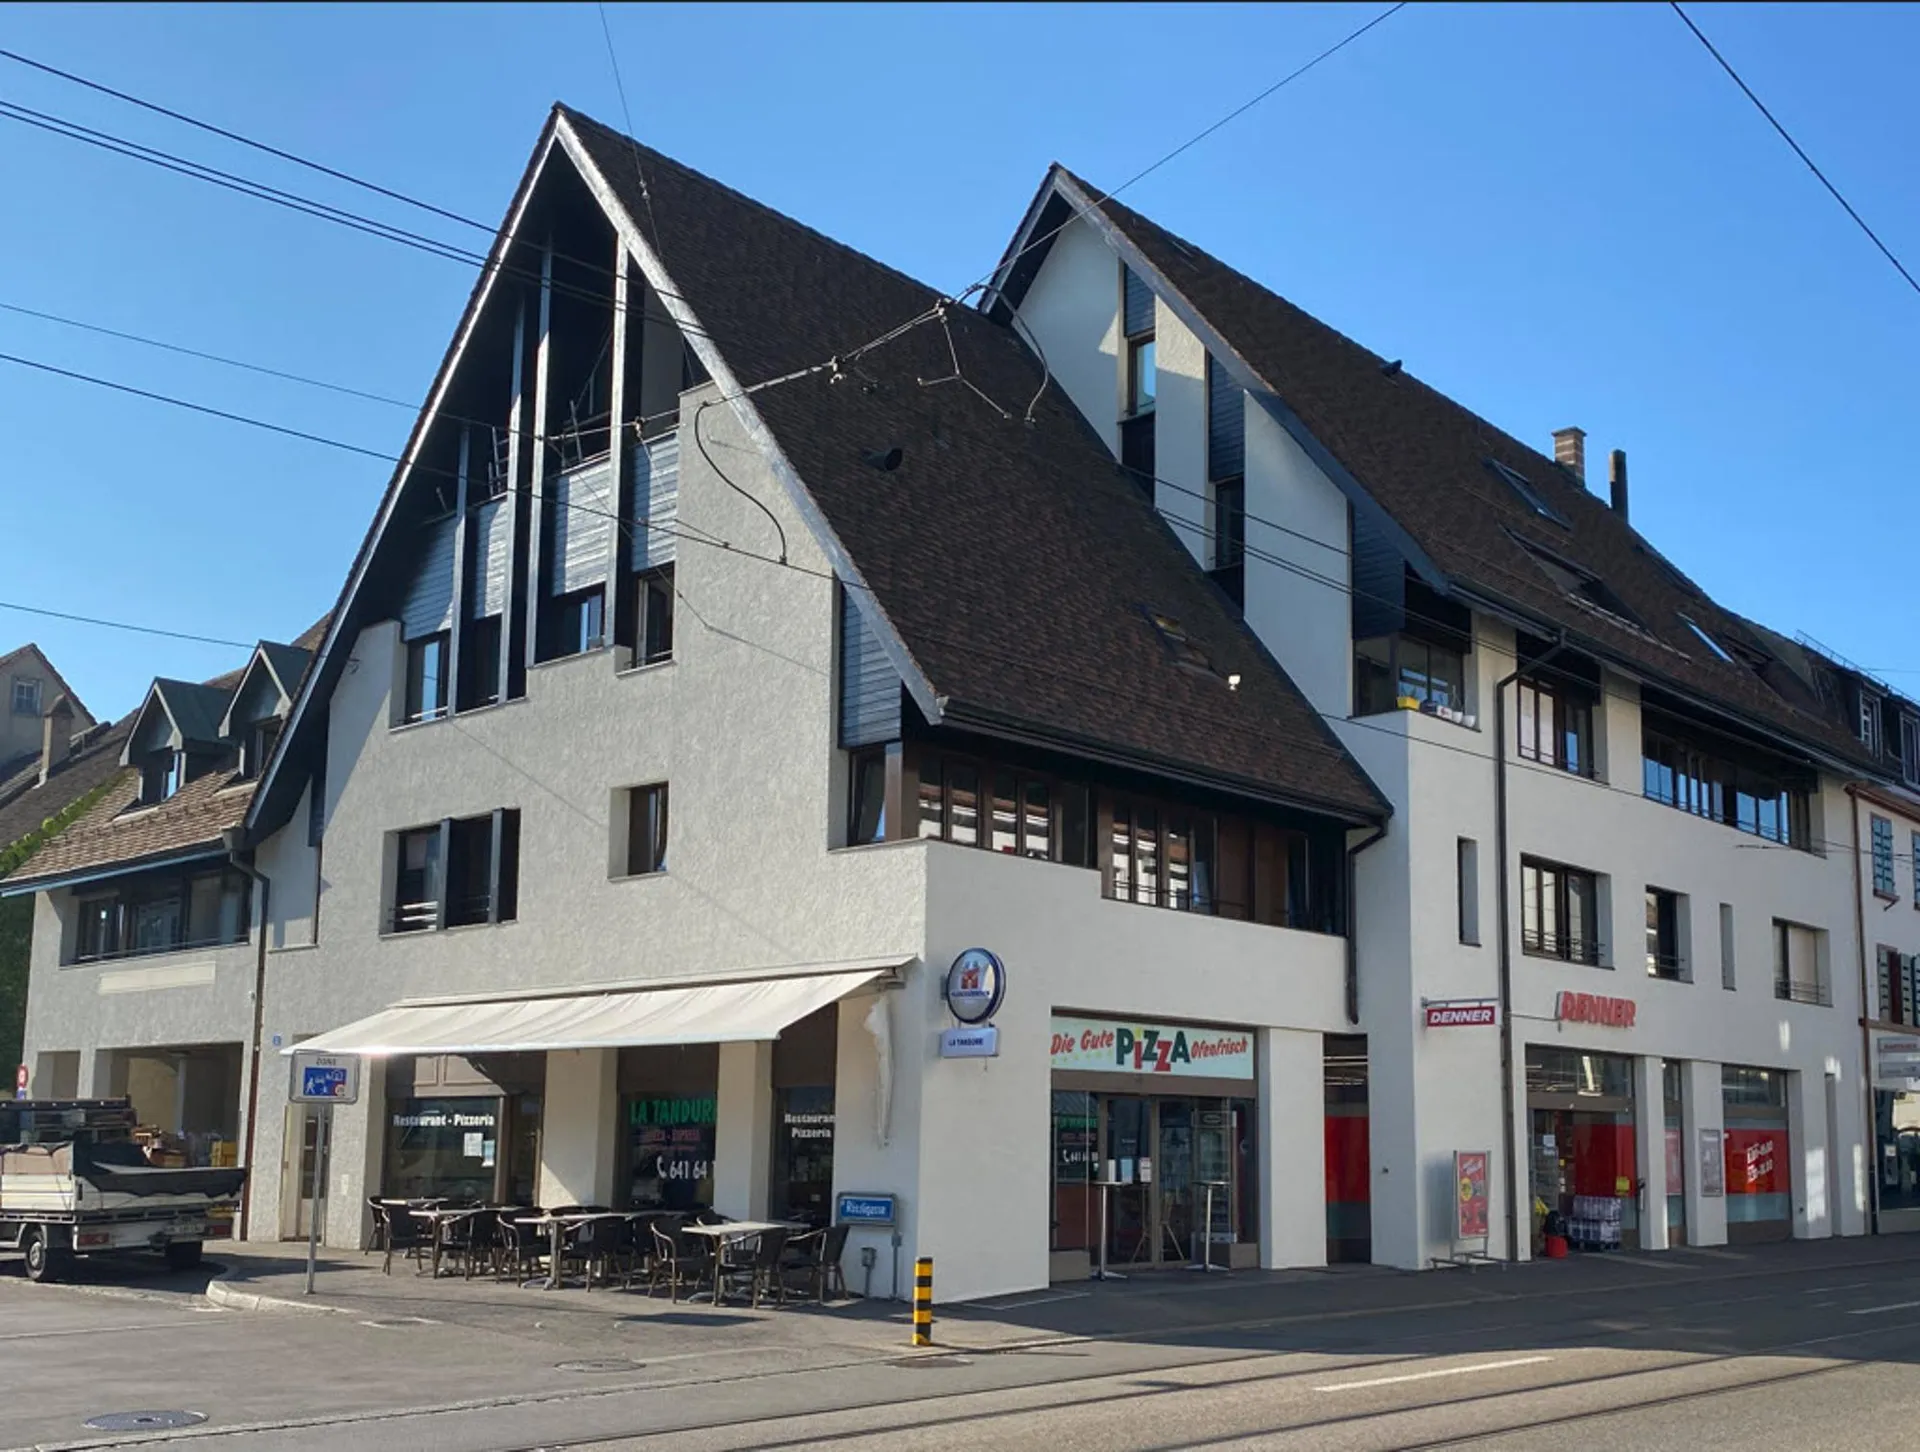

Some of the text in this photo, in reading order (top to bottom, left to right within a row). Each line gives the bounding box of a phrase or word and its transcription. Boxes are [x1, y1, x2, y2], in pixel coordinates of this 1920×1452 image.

[1430, 1009, 1492, 1023] DENNER
[1050, 1033, 1076, 1055] Die
[1080, 1028, 1115, 1051] Gute
[1191, 1036, 1248, 1059] Ofenfrisch
[631, 1099, 647, 1124] LA
[393, 1114, 446, 1127] Restaurant
[453, 1113, 495, 1126] Pizzeria
[792, 1127, 832, 1138] Pizzeria
[669, 1160, 689, 1179] 641
[693, 1160, 707, 1179] 64
